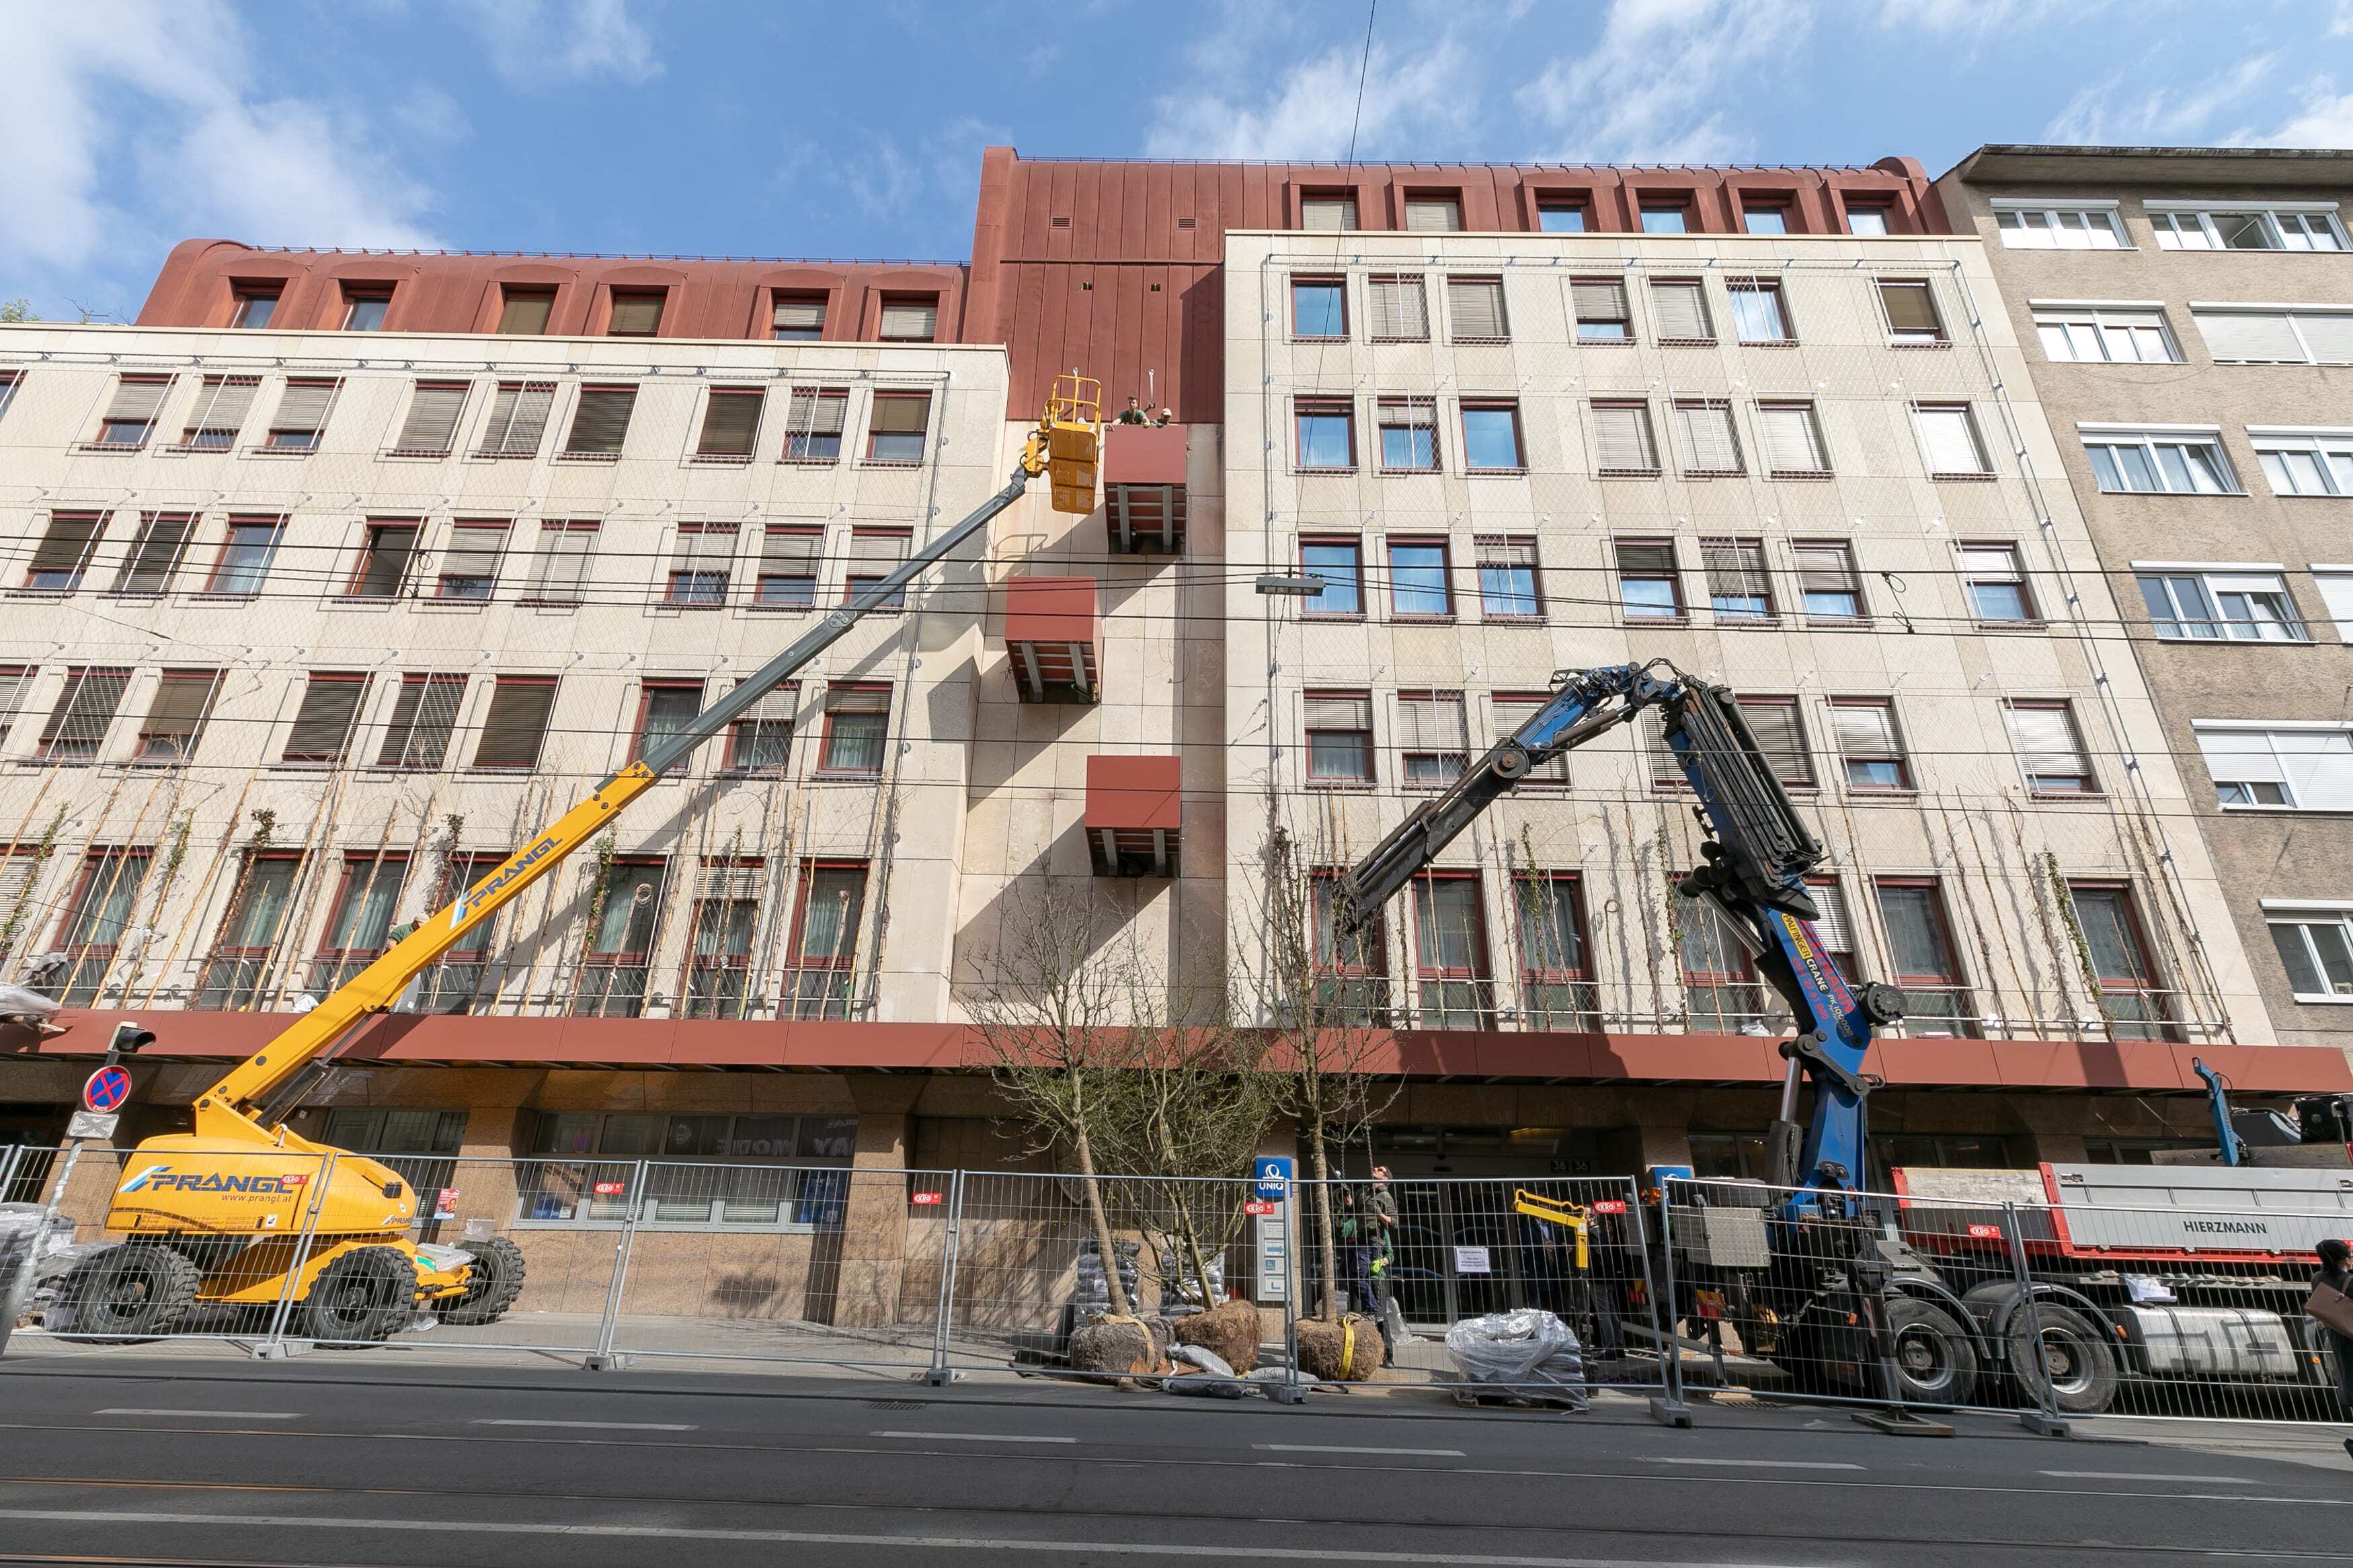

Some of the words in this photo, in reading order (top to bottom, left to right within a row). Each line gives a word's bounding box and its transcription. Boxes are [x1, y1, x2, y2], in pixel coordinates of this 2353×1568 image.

[462, 837, 563, 907] PRANGL
[1783, 914, 1811, 958] PALFINGER
[1806, 959, 1829, 991] CRANE
[1827, 994, 1837, 1005] PK
[1554, 1161, 1566, 1170] 38
[1575, 1161, 1587, 1170] 36
[150, 1172, 294, 1194] PRANGL
[1259, 1182, 1284, 1190] UNIQ
[221, 1194, 292, 1203] www.prangl.at
[2183, 1221, 2268, 1234] HIERZMANN
